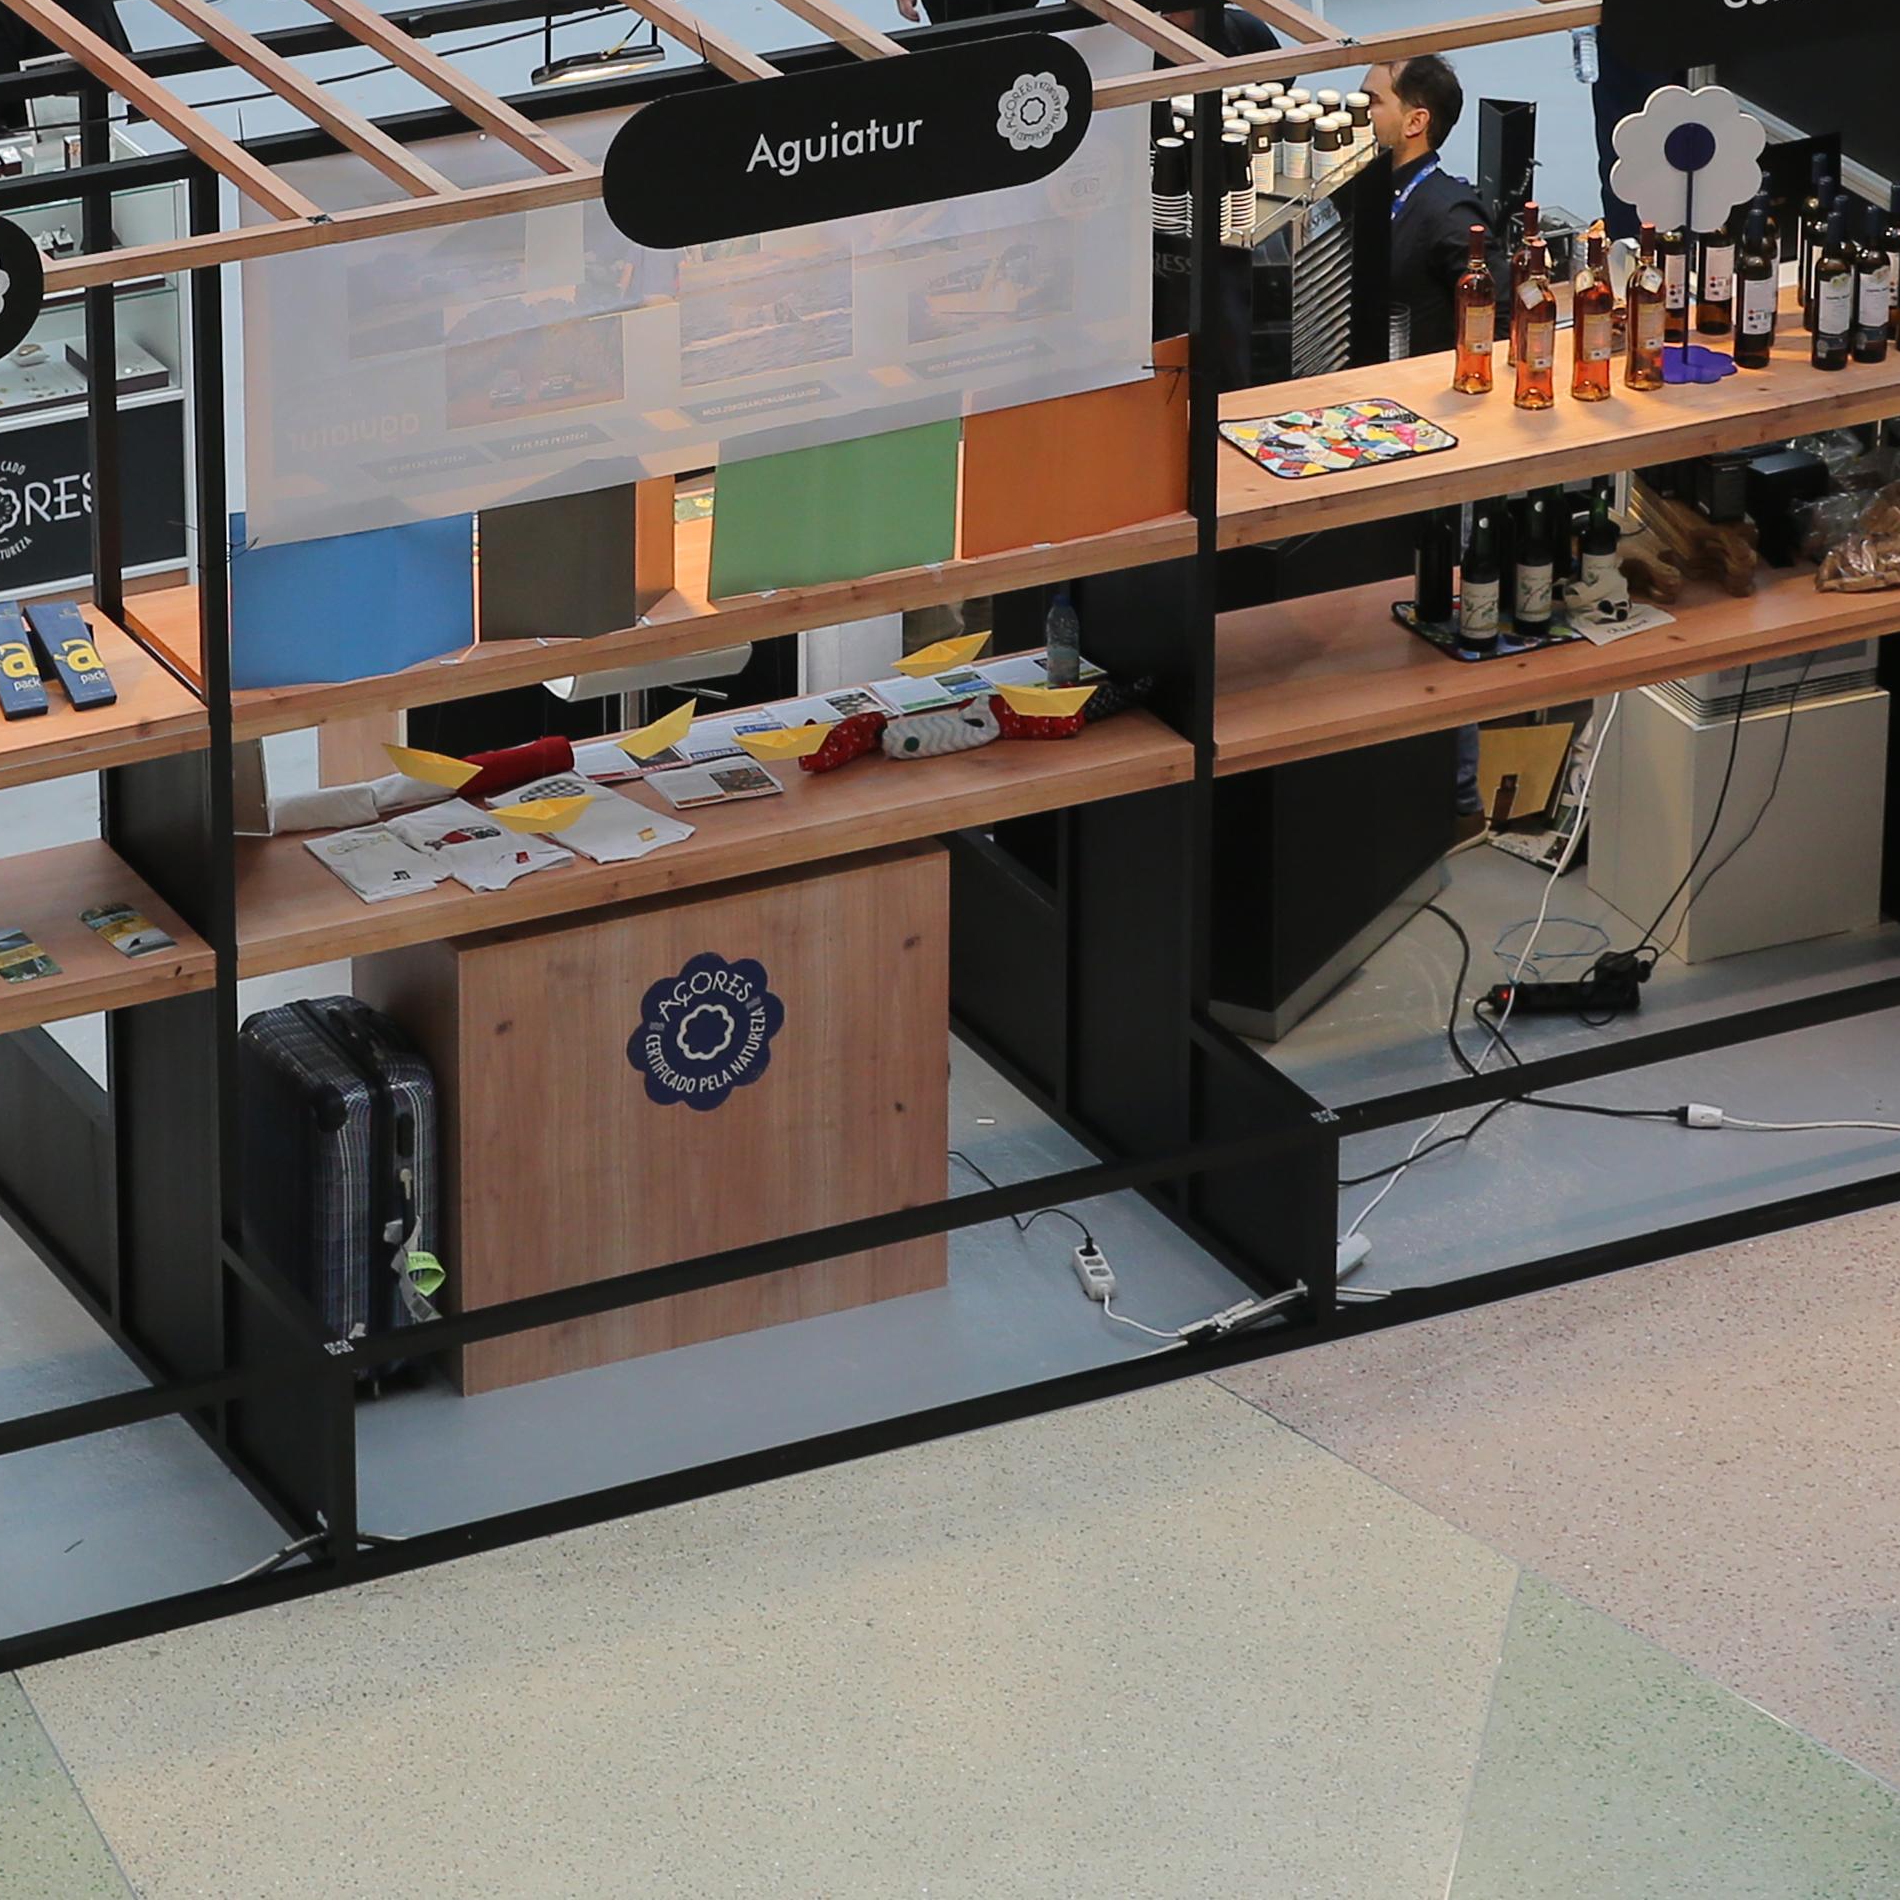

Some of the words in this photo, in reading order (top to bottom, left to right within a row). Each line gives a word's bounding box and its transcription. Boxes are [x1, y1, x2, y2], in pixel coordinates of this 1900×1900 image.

[746, 119, 924, 177] Aguiatur
[658, 970, 753, 1022] AÇORES
[645, 1033, 696, 1094] CERTIFICADO
[698, 1069, 733, 1093] PELA
[730, 1005, 766, 1077] NATUREZA
